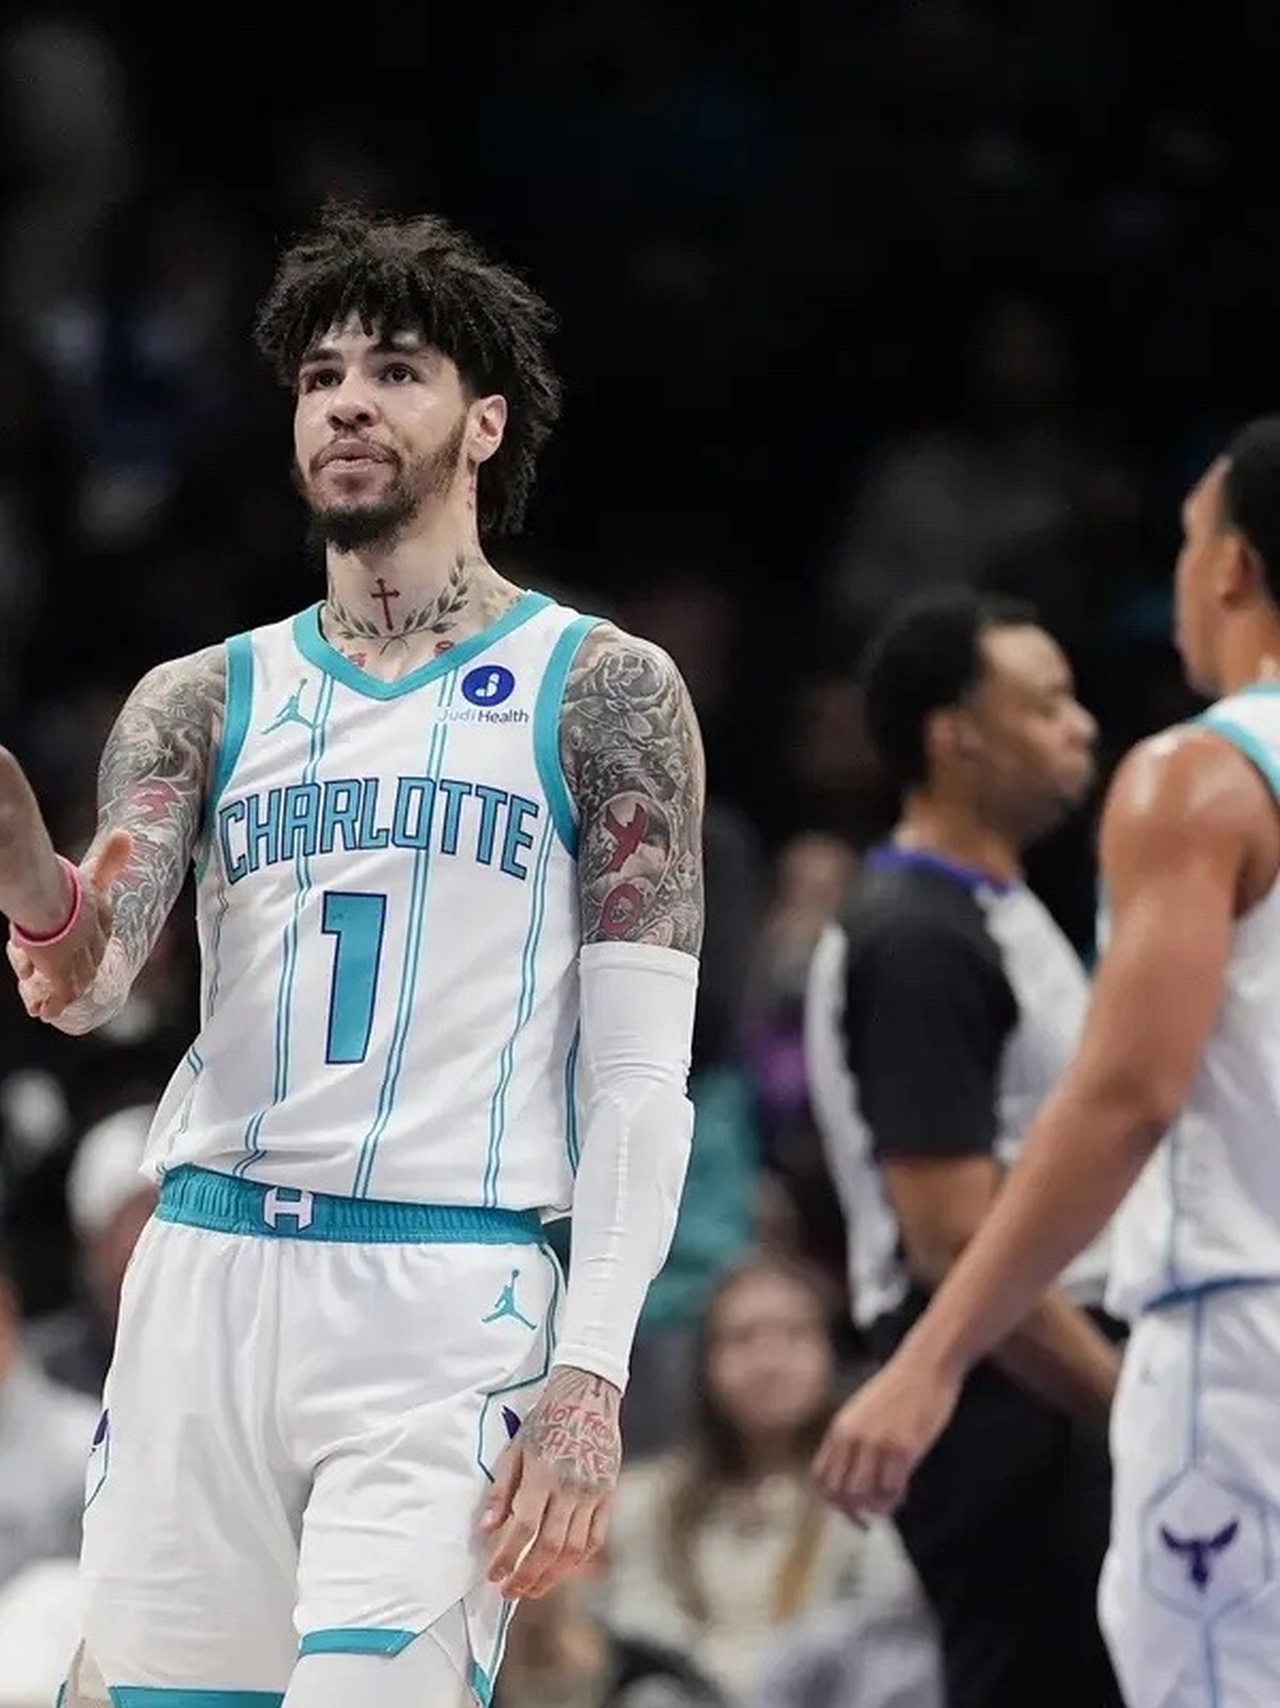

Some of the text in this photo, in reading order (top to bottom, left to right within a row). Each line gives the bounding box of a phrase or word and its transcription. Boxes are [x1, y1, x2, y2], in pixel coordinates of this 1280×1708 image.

[477, 708, 530, 725] Health
[220, 776, 540, 885] CHARLOTTE
[321, 890, 387, 1065] 1
[542, 1401, 580, 1425] NOT
